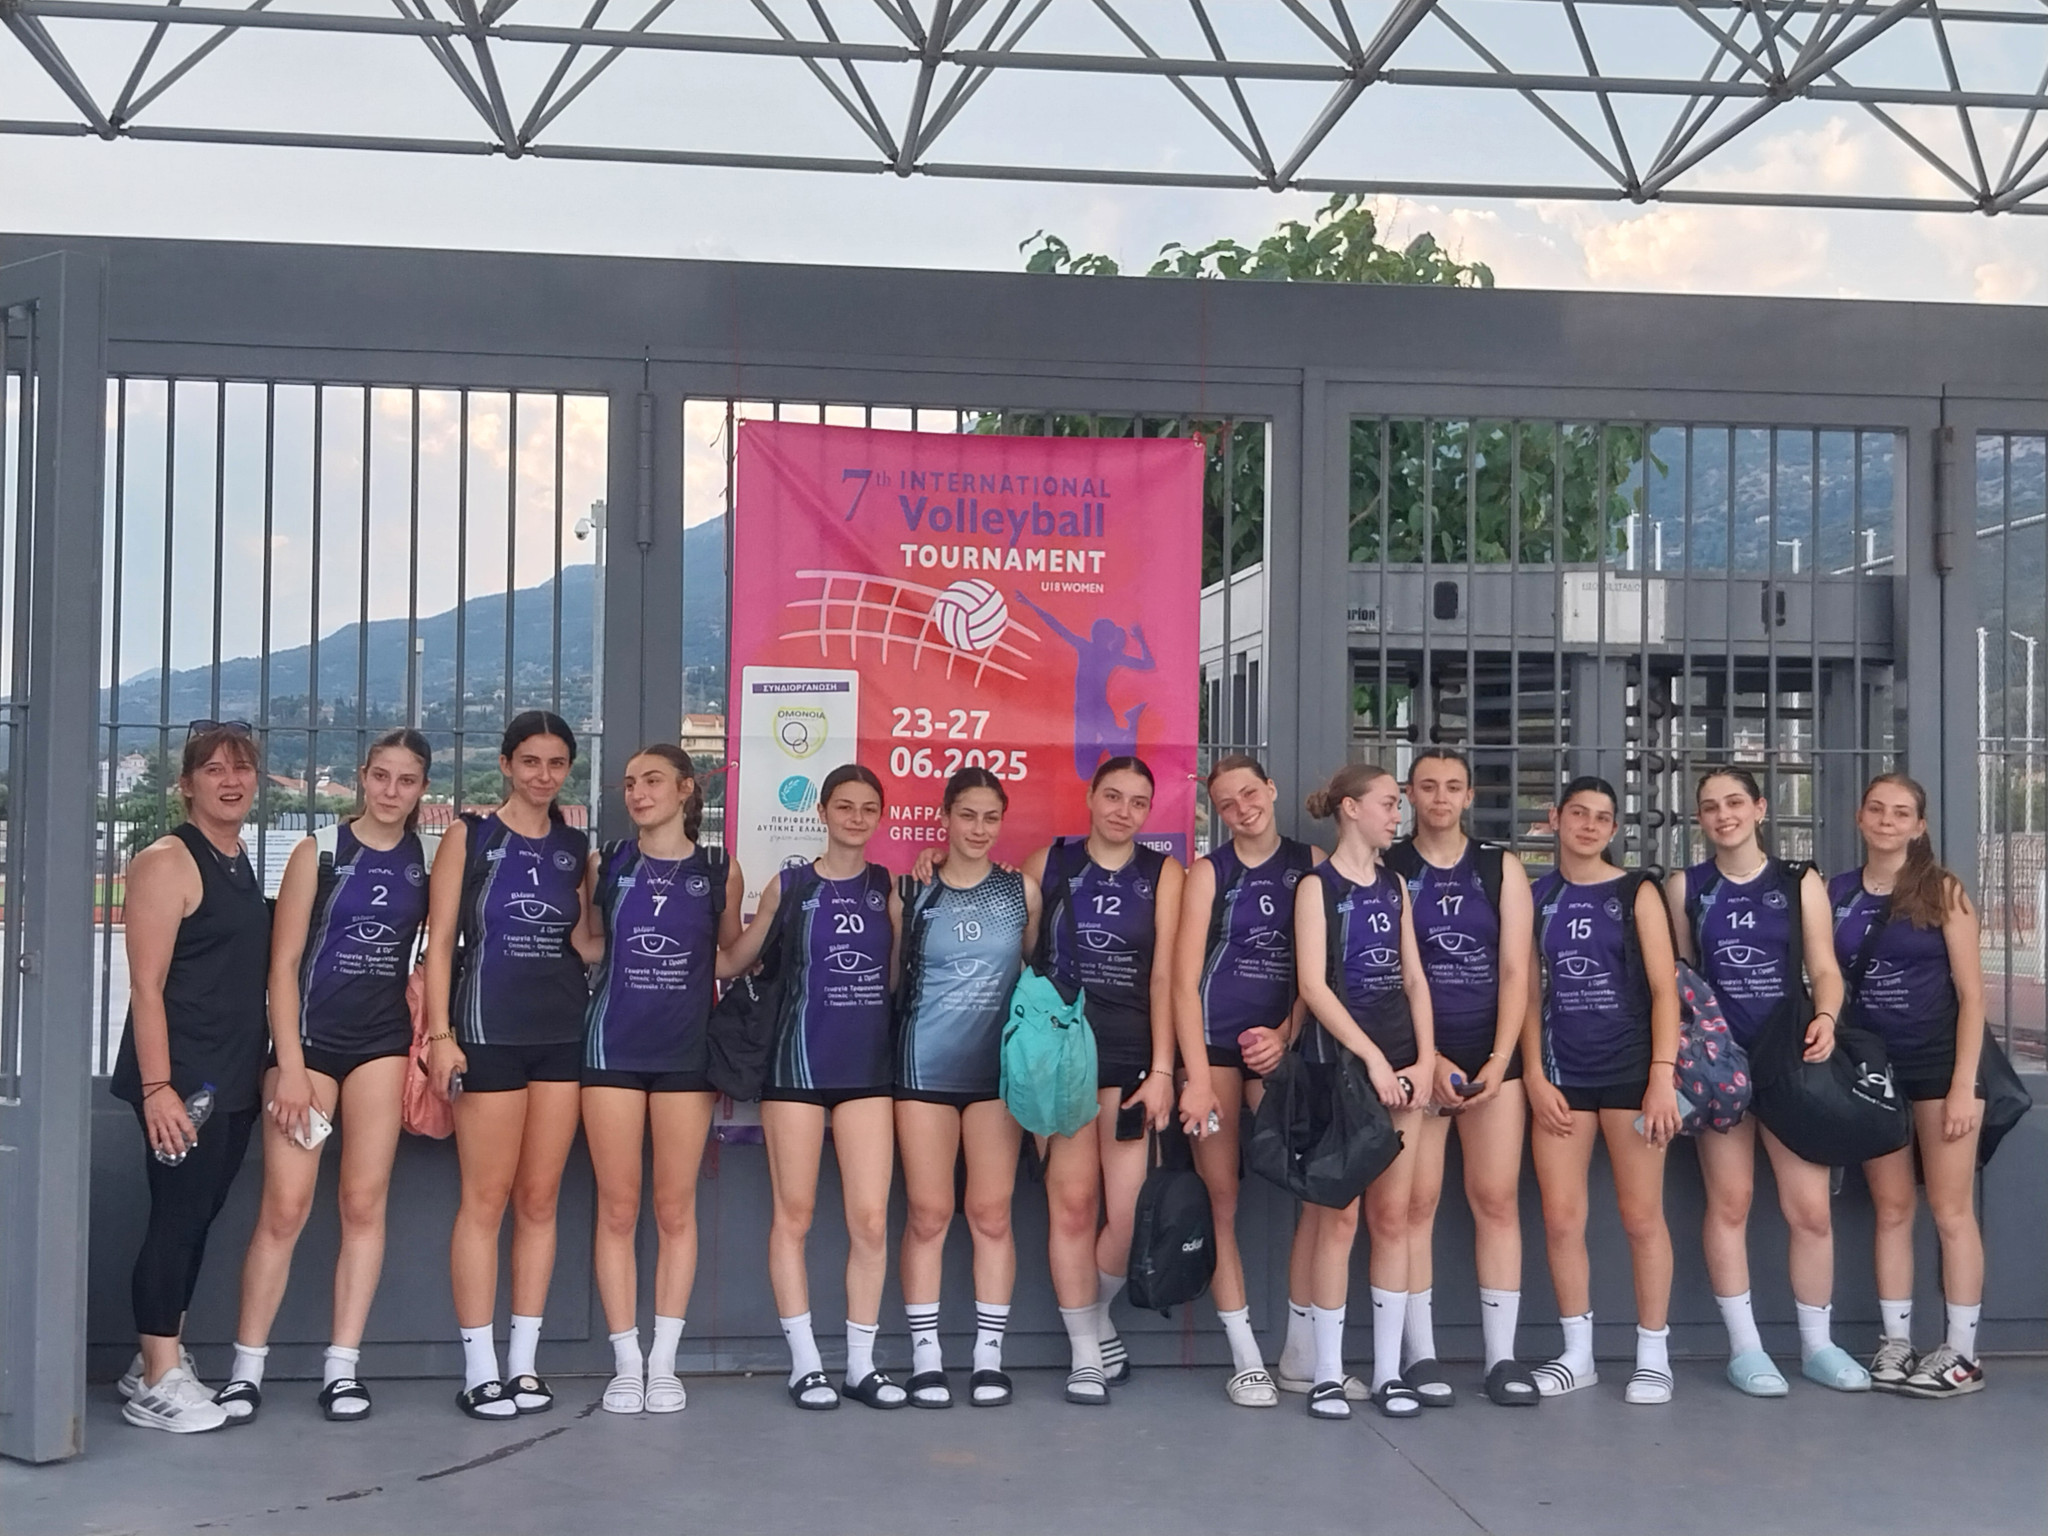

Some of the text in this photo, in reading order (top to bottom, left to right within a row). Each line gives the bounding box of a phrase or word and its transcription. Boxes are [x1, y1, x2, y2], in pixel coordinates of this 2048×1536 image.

[900, 470, 1111, 498] INTERNATIONAL
[899, 495, 1105, 546] Volleyball
[901, 543, 1106, 574] TOURNAMENT
[1062, 582, 1105, 594] WOMEN
[763, 683, 837, 693] ΣΥΝΔΙΟΡΓΑΝΩΣΗ
[892, 706, 990, 740] 23-27
[890, 746, 1028, 781] 06.2025
[771, 815, 822, 824] ΠΕΡΙΦΕΡΕΙ
[889, 805, 942, 821] NAFPA
[799, 825, 828, 833] ΕΛΛΑΔ
[889, 825, 947, 842] GREEC
[527, 867, 539, 886] 1
[371, 885, 389, 906] 2
[652, 895, 668, 916] 7
[1092, 894, 1122, 915] 12
[1259, 895, 1275, 915] 6
[1436, 895, 1464, 916] 17
[833, 913, 865, 934] 20
[1367, 912, 1392, 933] 13
[1566, 918, 1592, 939] 15
[1726, 911, 1756, 929] 14
[953, 920, 982, 942] 19
[1240, 1374, 1272, 1385] FILA
